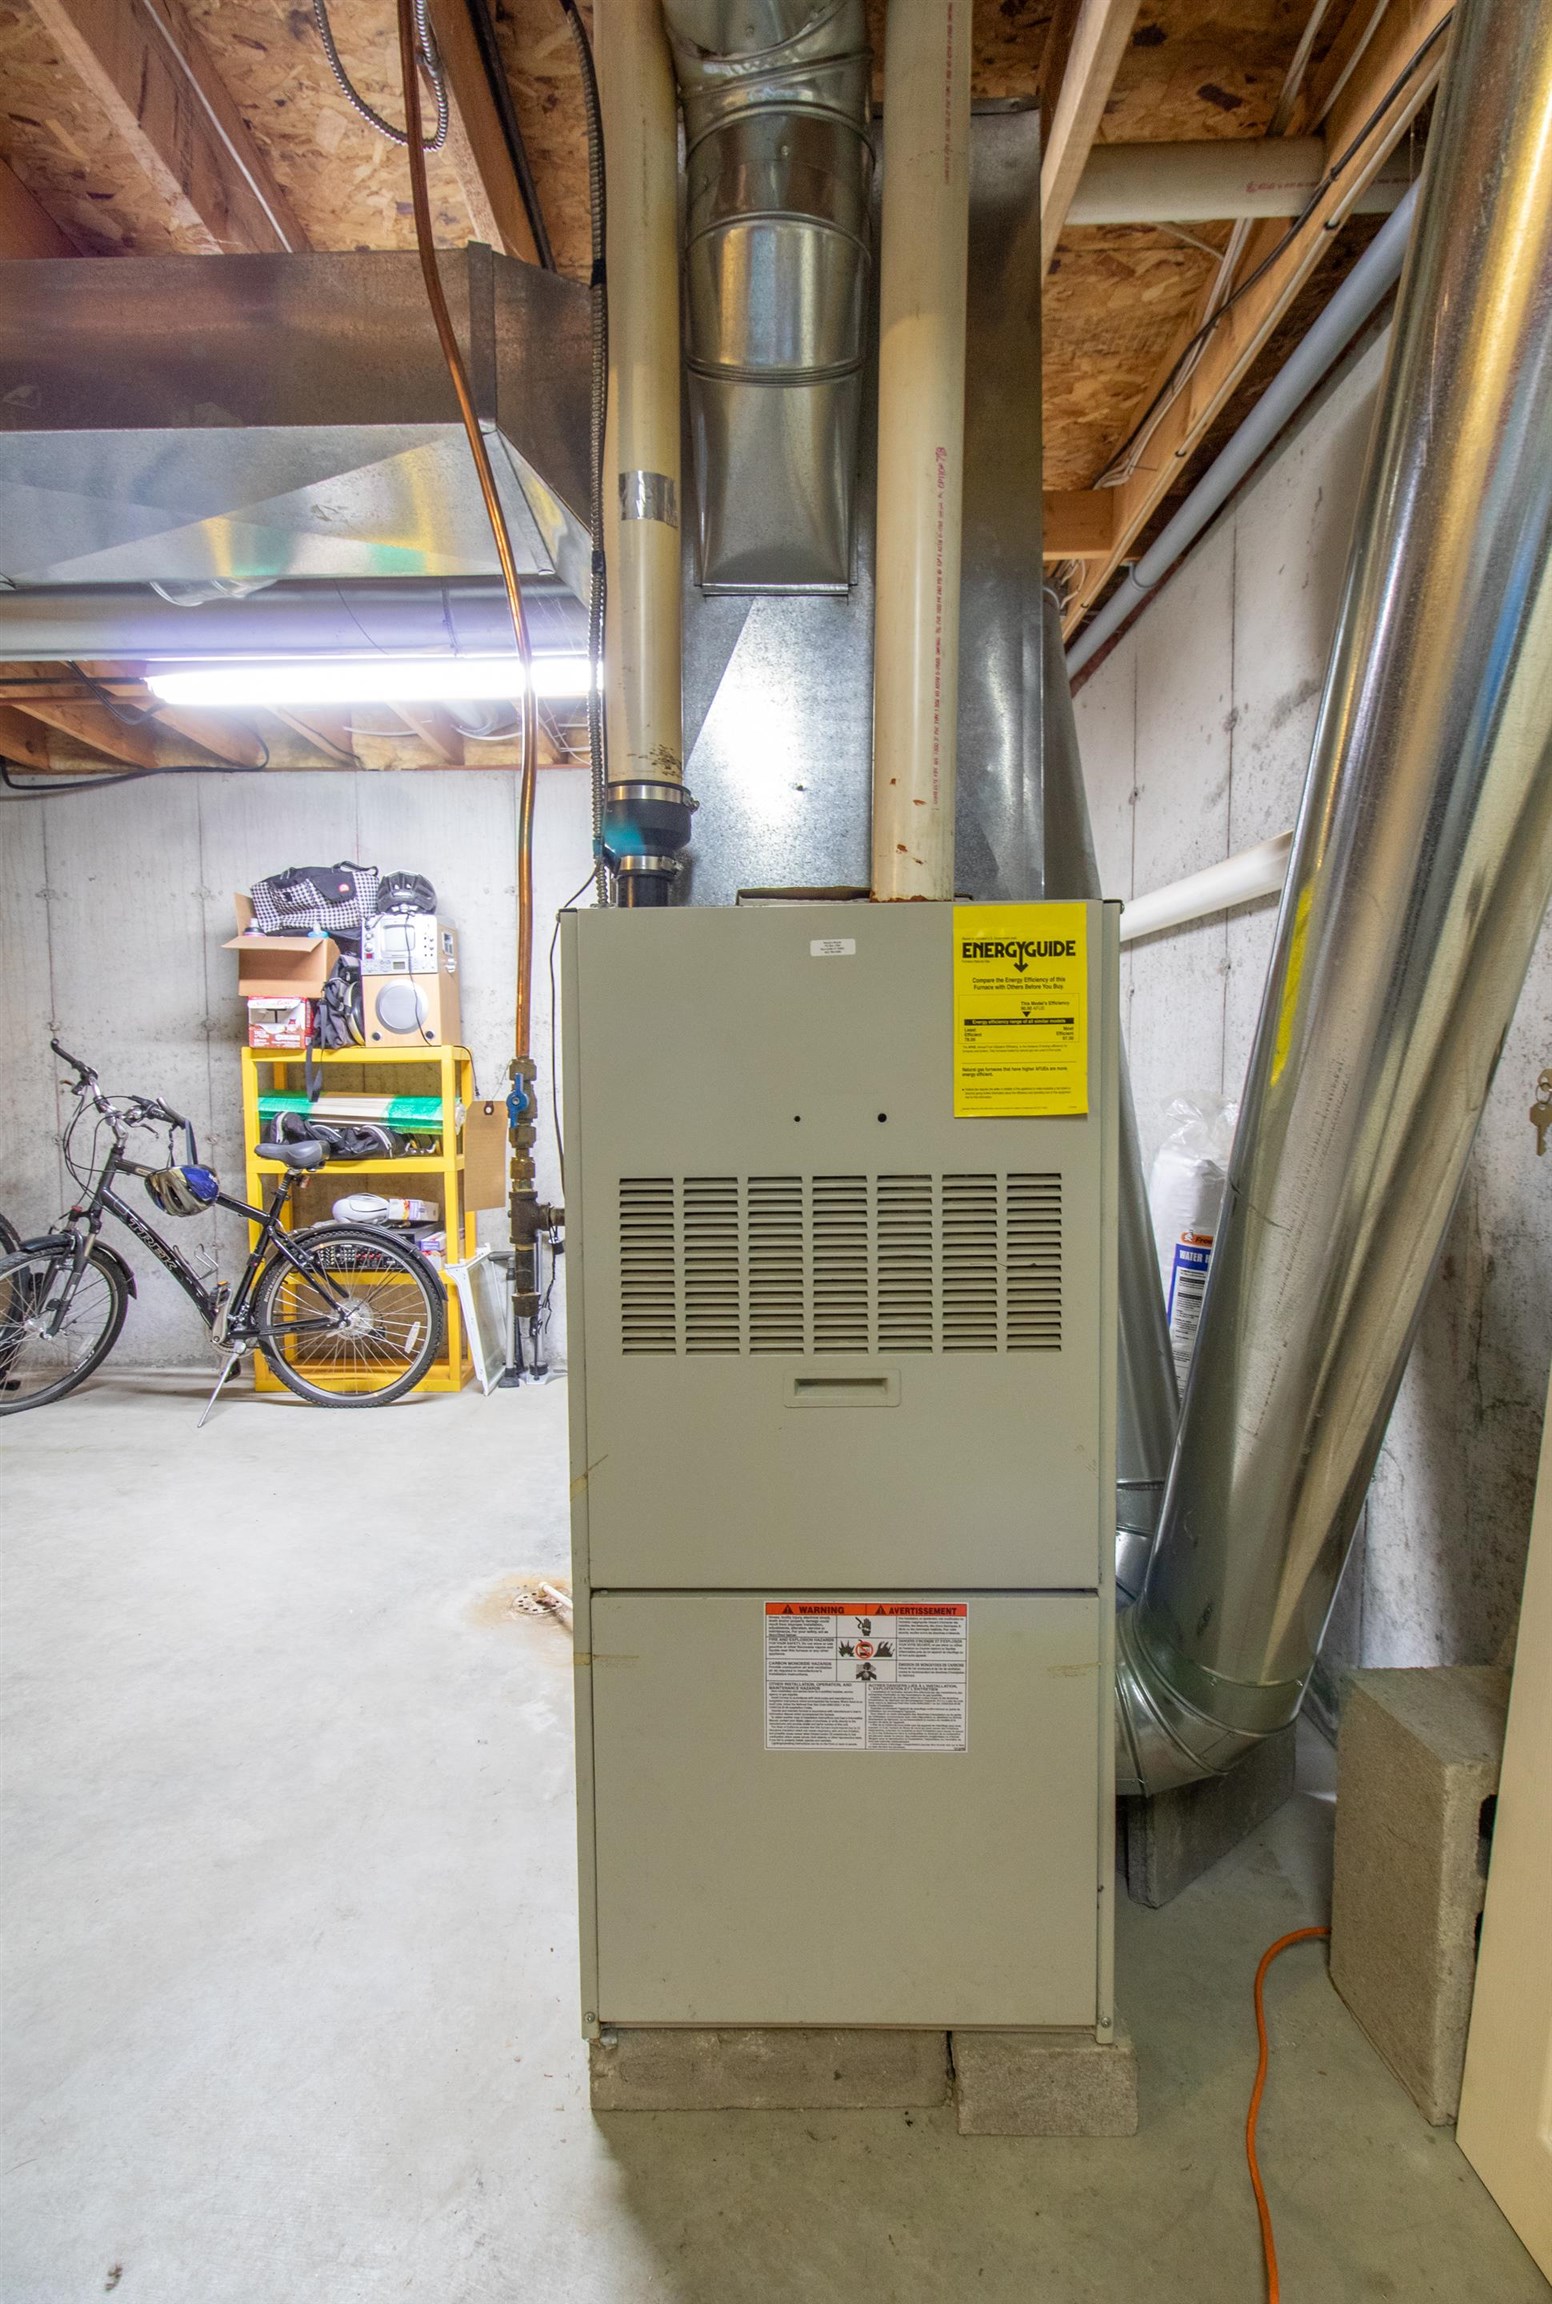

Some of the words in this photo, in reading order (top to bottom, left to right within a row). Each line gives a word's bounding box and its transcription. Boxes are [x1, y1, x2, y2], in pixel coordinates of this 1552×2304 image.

[962, 940, 1076, 960] ENERGYGUIDE
[128, 1217, 178, 1270] TREK
[1179, 1249, 1203, 1263] WATER
[799, 1606, 845, 1614] WARNING
[889, 1606, 957, 1615] AVERTISSEMENT
